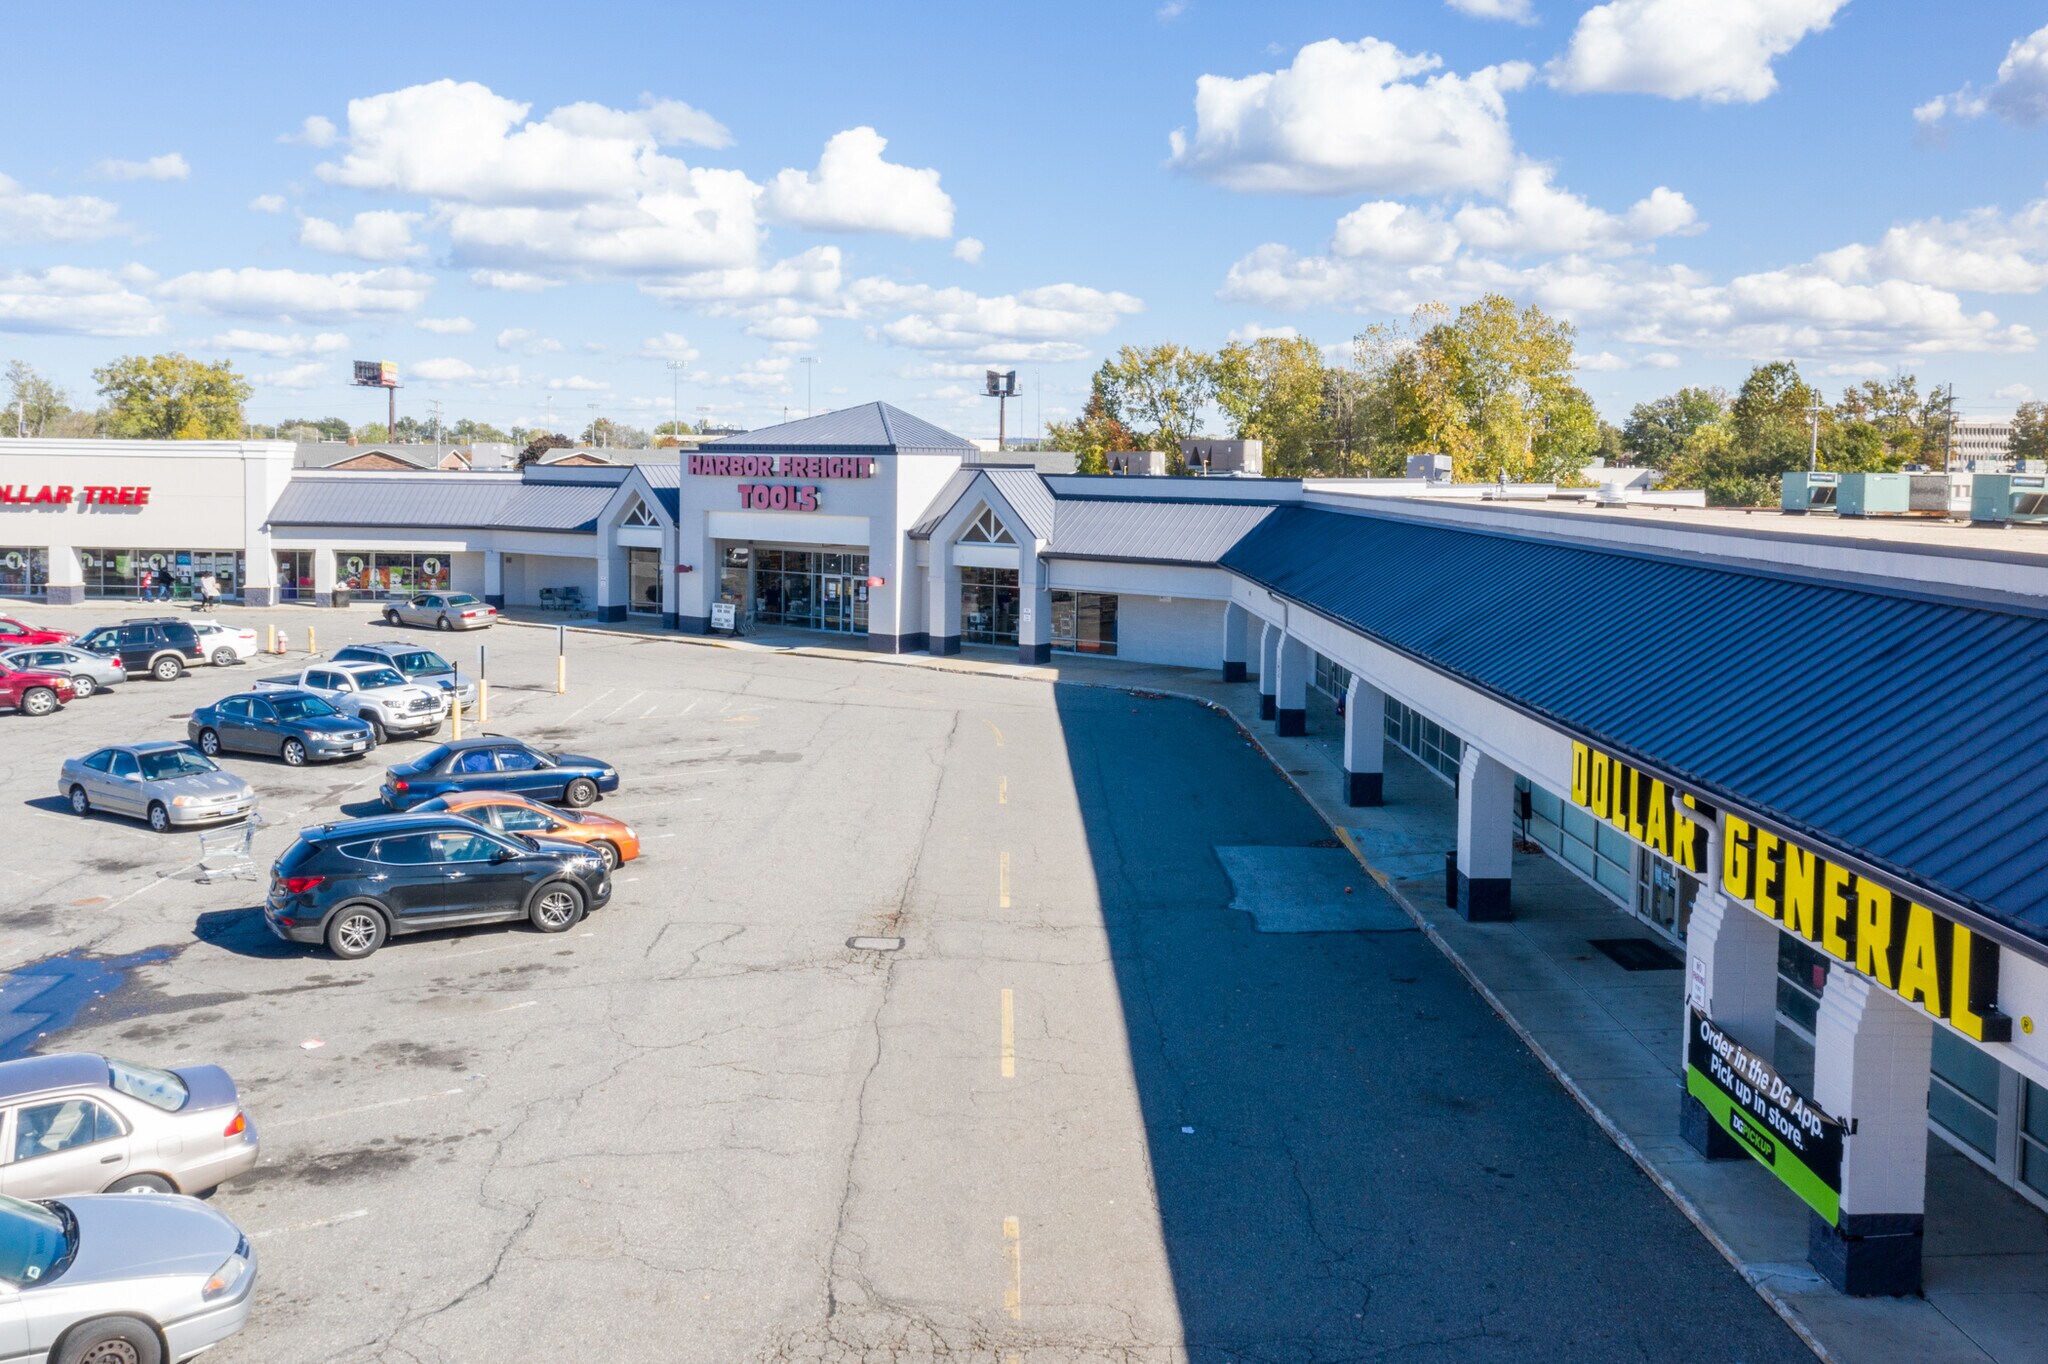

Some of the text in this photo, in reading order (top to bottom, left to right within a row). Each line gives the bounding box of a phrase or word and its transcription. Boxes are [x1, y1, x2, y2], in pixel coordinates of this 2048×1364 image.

[0, 485, 151, 505] LLAR TREE
[688, 455, 874, 479] HARBOR FREIGHT
[738, 484, 818, 511] TOOLS
[1571, 739, 1697, 873] DOLLAR
[1723, 813, 1984, 1042] GENERAL
[1700, 1020, 1824, 1139] Order in the DG App.
[1710, 1053, 1804, 1151] Pick up in store.
